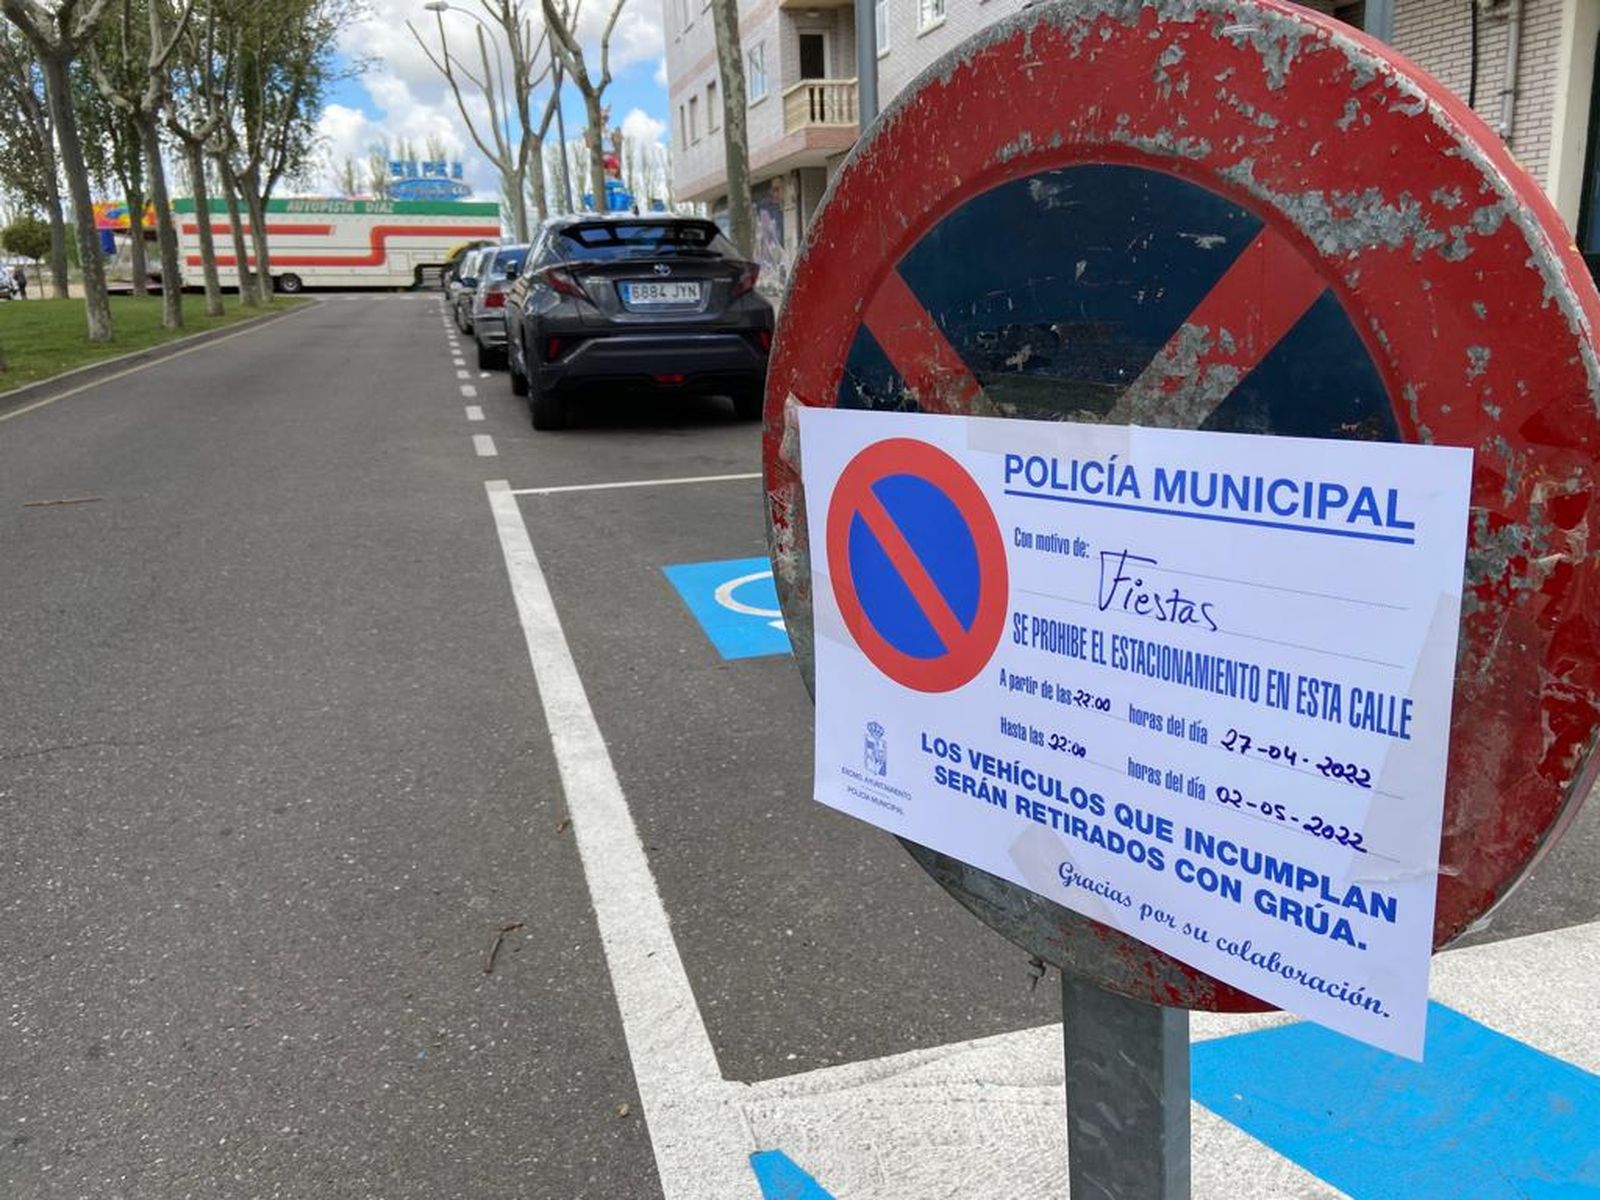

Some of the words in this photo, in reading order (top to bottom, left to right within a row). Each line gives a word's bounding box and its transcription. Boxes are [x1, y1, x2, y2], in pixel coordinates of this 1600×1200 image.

[286, 199, 355, 214] AUTOPISTA
[632, 286, 666, 299] 6884
[672, 284, 697, 298] JYN
[1004, 453, 1141, 499] POLICÍA
[1153, 467, 1415, 530] MUNICIPAL
[1014, 527, 1032, 549] Con
[1035, 531, 1070, 557] motivo
[1073, 537, 1090, 559] de:
[1098, 549, 1219, 632] Fiestas
[1000, 668, 1007, 686] A
[1009, 674, 1038, 696] partir
[1041, 680, 1053, 700] de
[1056, 683, 1072, 705] las
[1013, 612, 1029, 645] SE
[1032, 618, 1087, 660] PROHIBE
[1091, 630, 1107, 665] EL
[1111, 634, 1261, 703] ESTACIONAMIENTO
[1266, 669, 1289, 711] EN
[1296, 675, 1342, 724] ESTA
[1349, 687, 1413, 740] CALLE
[1073, 689, 1111, 712] 22:00
[1000, 716, 1027, 741] Hasta
[1029, 724, 1044, 747] las
[1129, 703, 1163, 732] horas
[1167, 715, 1185, 738] del
[1189, 720, 1208, 744] día
[1048, 733, 1087, 758] 22:00
[1128, 757, 1161, 786] horas
[1165, 770, 1183, 794] del
[1187, 777, 1206, 801] día
[921, 732, 963, 763] LOS
[968, 748, 1106, 817] VEHÍCULOS
[1114, 802, 1174, 843] QUE
[1185, 827, 1398, 923] INCUMPLAN
[934, 765, 1008, 810] SERÁN
[1015, 795, 1166, 872] RETIRADOS
[1175, 857, 1242, 904] CON
[1255, 887, 1368, 951] GRÚA.
[1058, 861, 1133, 908] Gracias
[1139, 902, 1177, 931] por
[1182, 919, 1210, 944] su
[1216, 934, 1391, 1019] colaboración.
